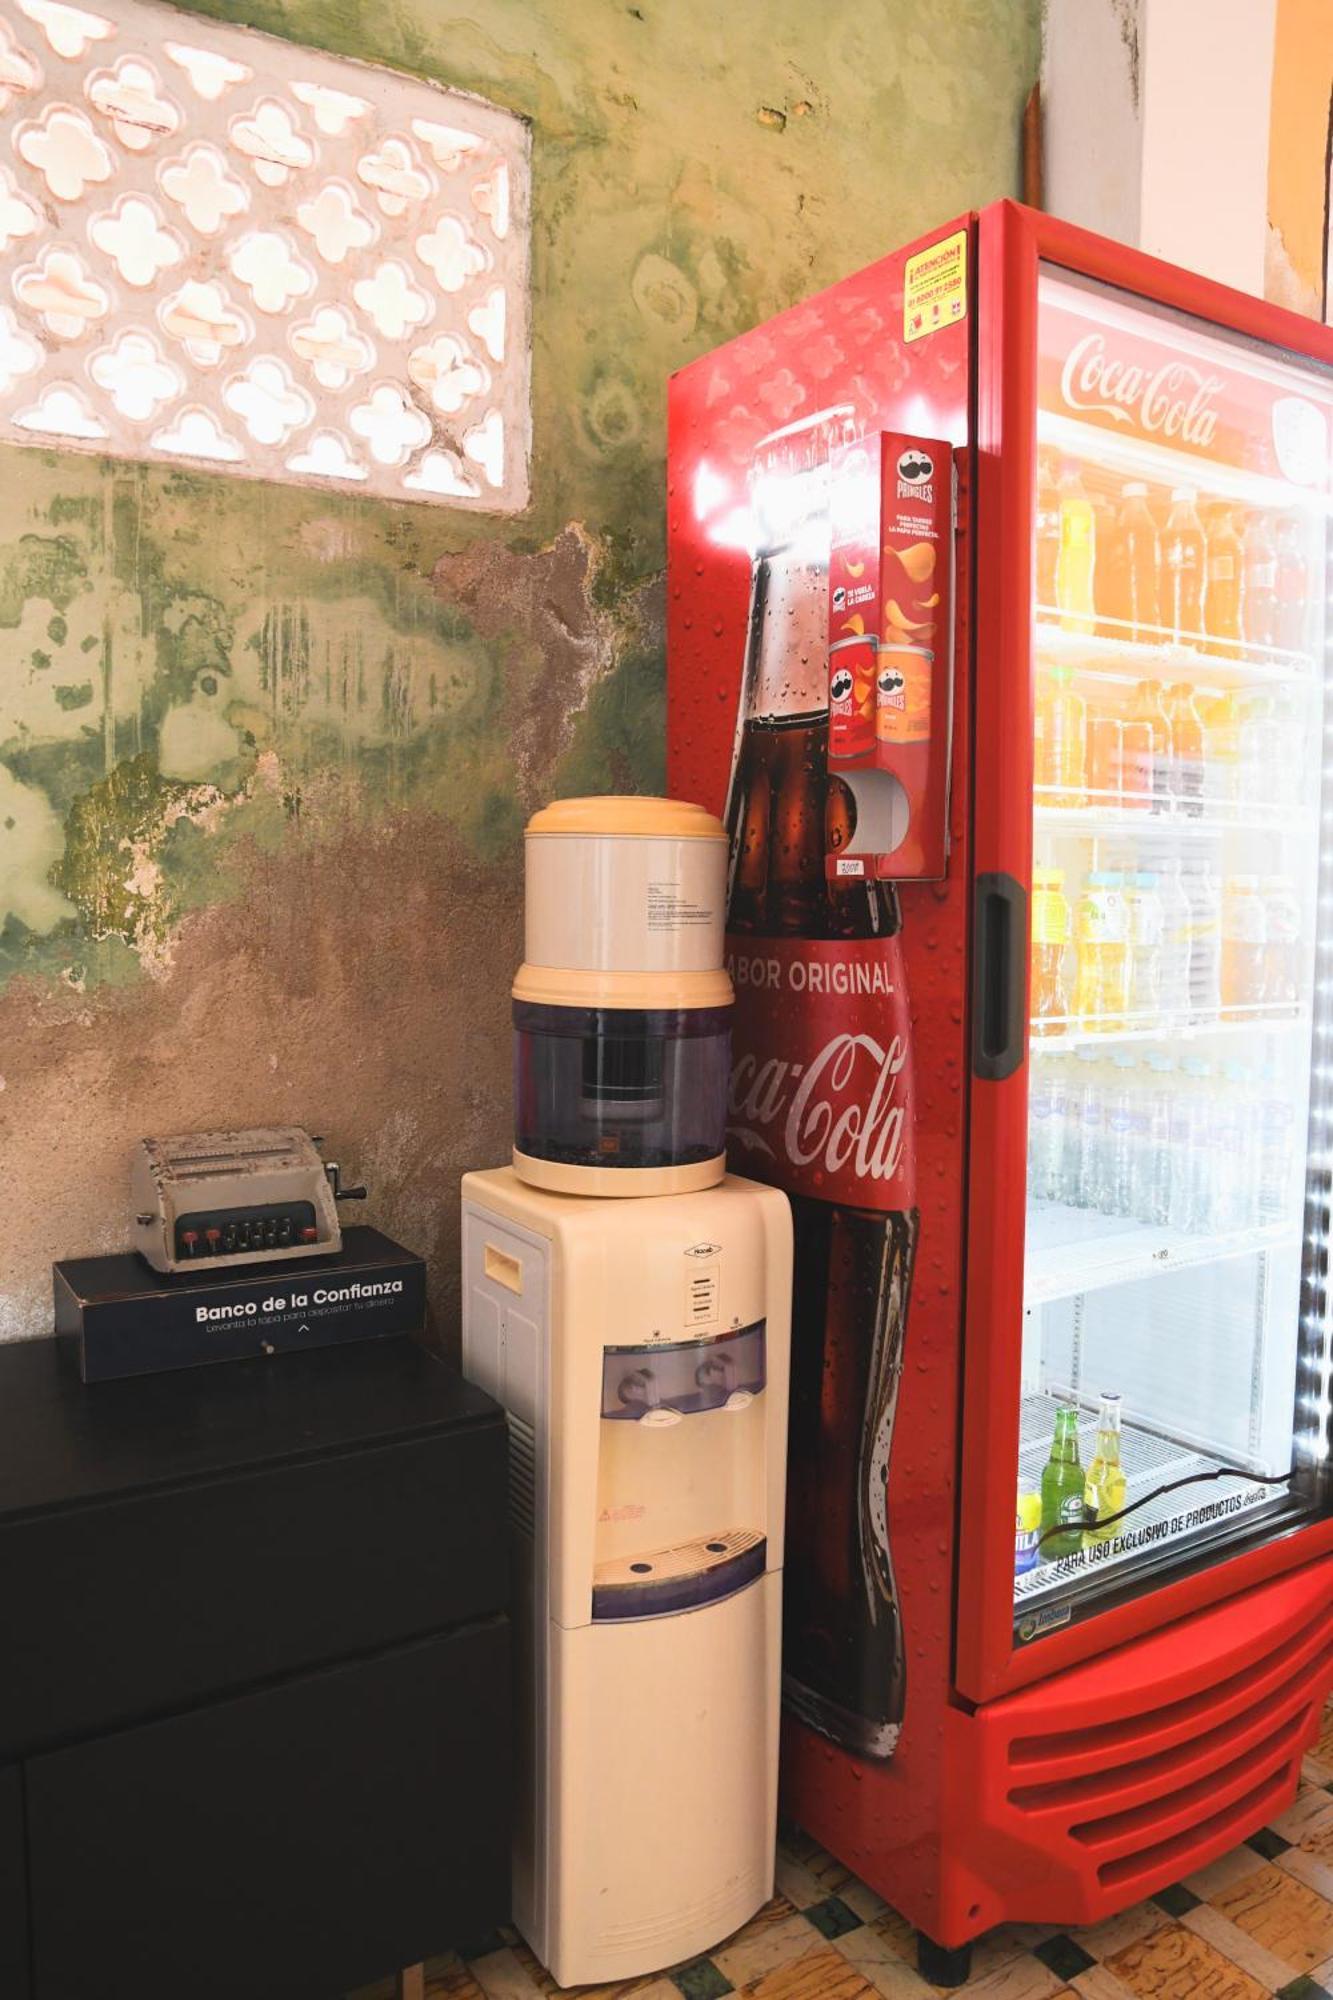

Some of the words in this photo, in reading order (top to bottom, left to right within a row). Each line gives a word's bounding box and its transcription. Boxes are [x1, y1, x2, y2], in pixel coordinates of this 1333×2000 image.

[1061, 333, 1227, 447] Coca-Cola
[896, 479, 933, 503] PRINGLES
[727, 954, 781, 989] ABOR
[788, 961, 895, 995] ORIGINAL
[727, 1033, 908, 1181] ca-Cola
[196, 1302, 257, 1322] Banco
[262, 1297, 286, 1312] de
[291, 1294, 308, 1308] la
[313, 1281, 403, 1304] Confianza
[206, 1320, 245, 1333] Levanta
[1056, 1548, 1086, 1573] PARA
[1088, 1540, 1110, 1563] USO
[1113, 1521, 1168, 1554] EXCLUSIVO
[1171, 1514, 1185, 1534] DE
[1185, 1495, 1241, 1529] PRODUCTOS
